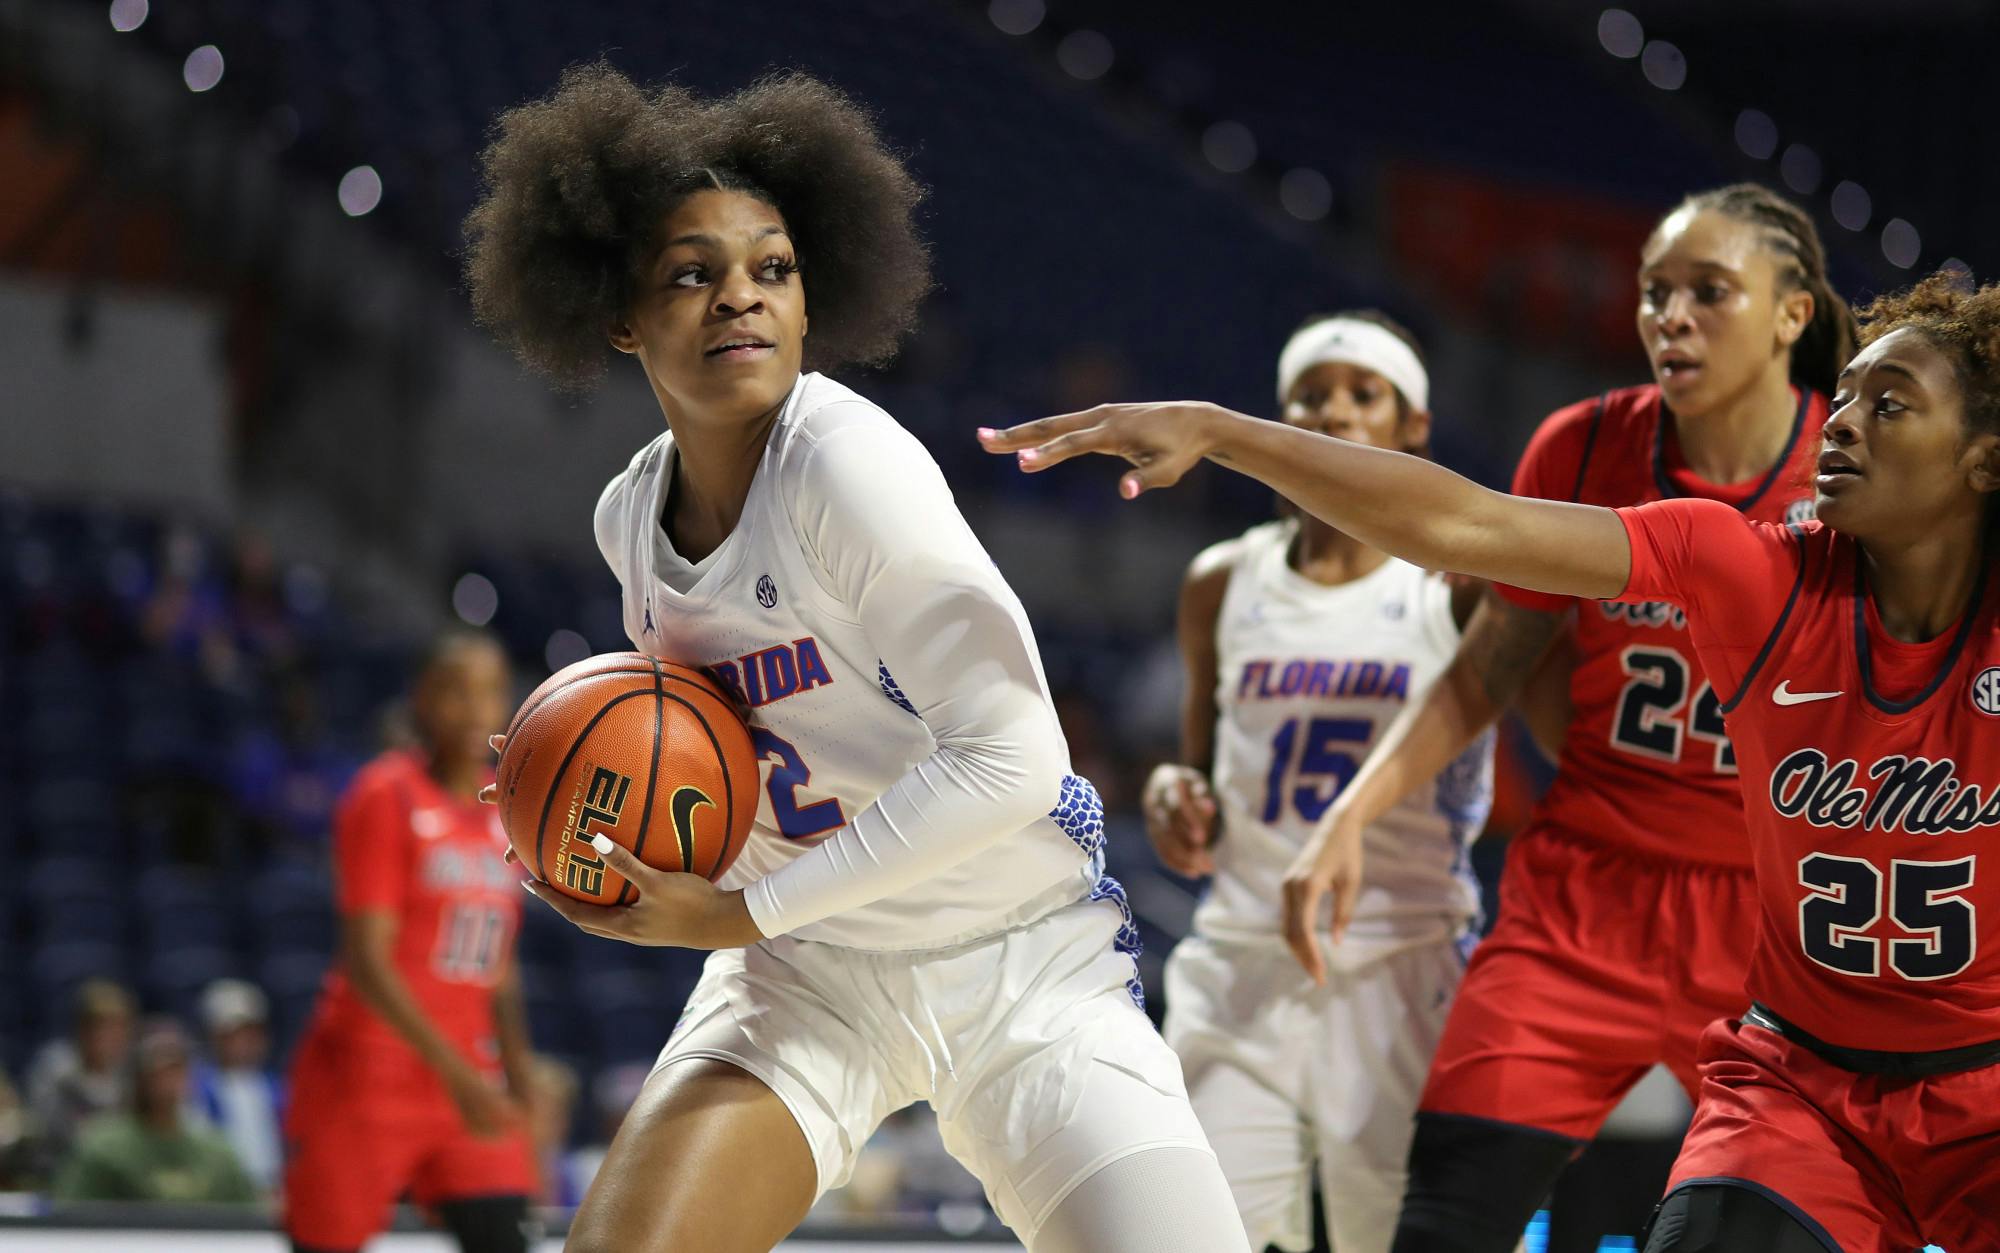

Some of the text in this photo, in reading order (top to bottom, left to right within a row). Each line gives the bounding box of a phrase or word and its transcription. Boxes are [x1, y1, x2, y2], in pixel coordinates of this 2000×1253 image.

[1238, 659, 1412, 703] FLORIDA
[1262, 716, 1375, 825] 15
[1769, 748, 1868, 828] Ole
[1798, 852, 1977, 981] 25
